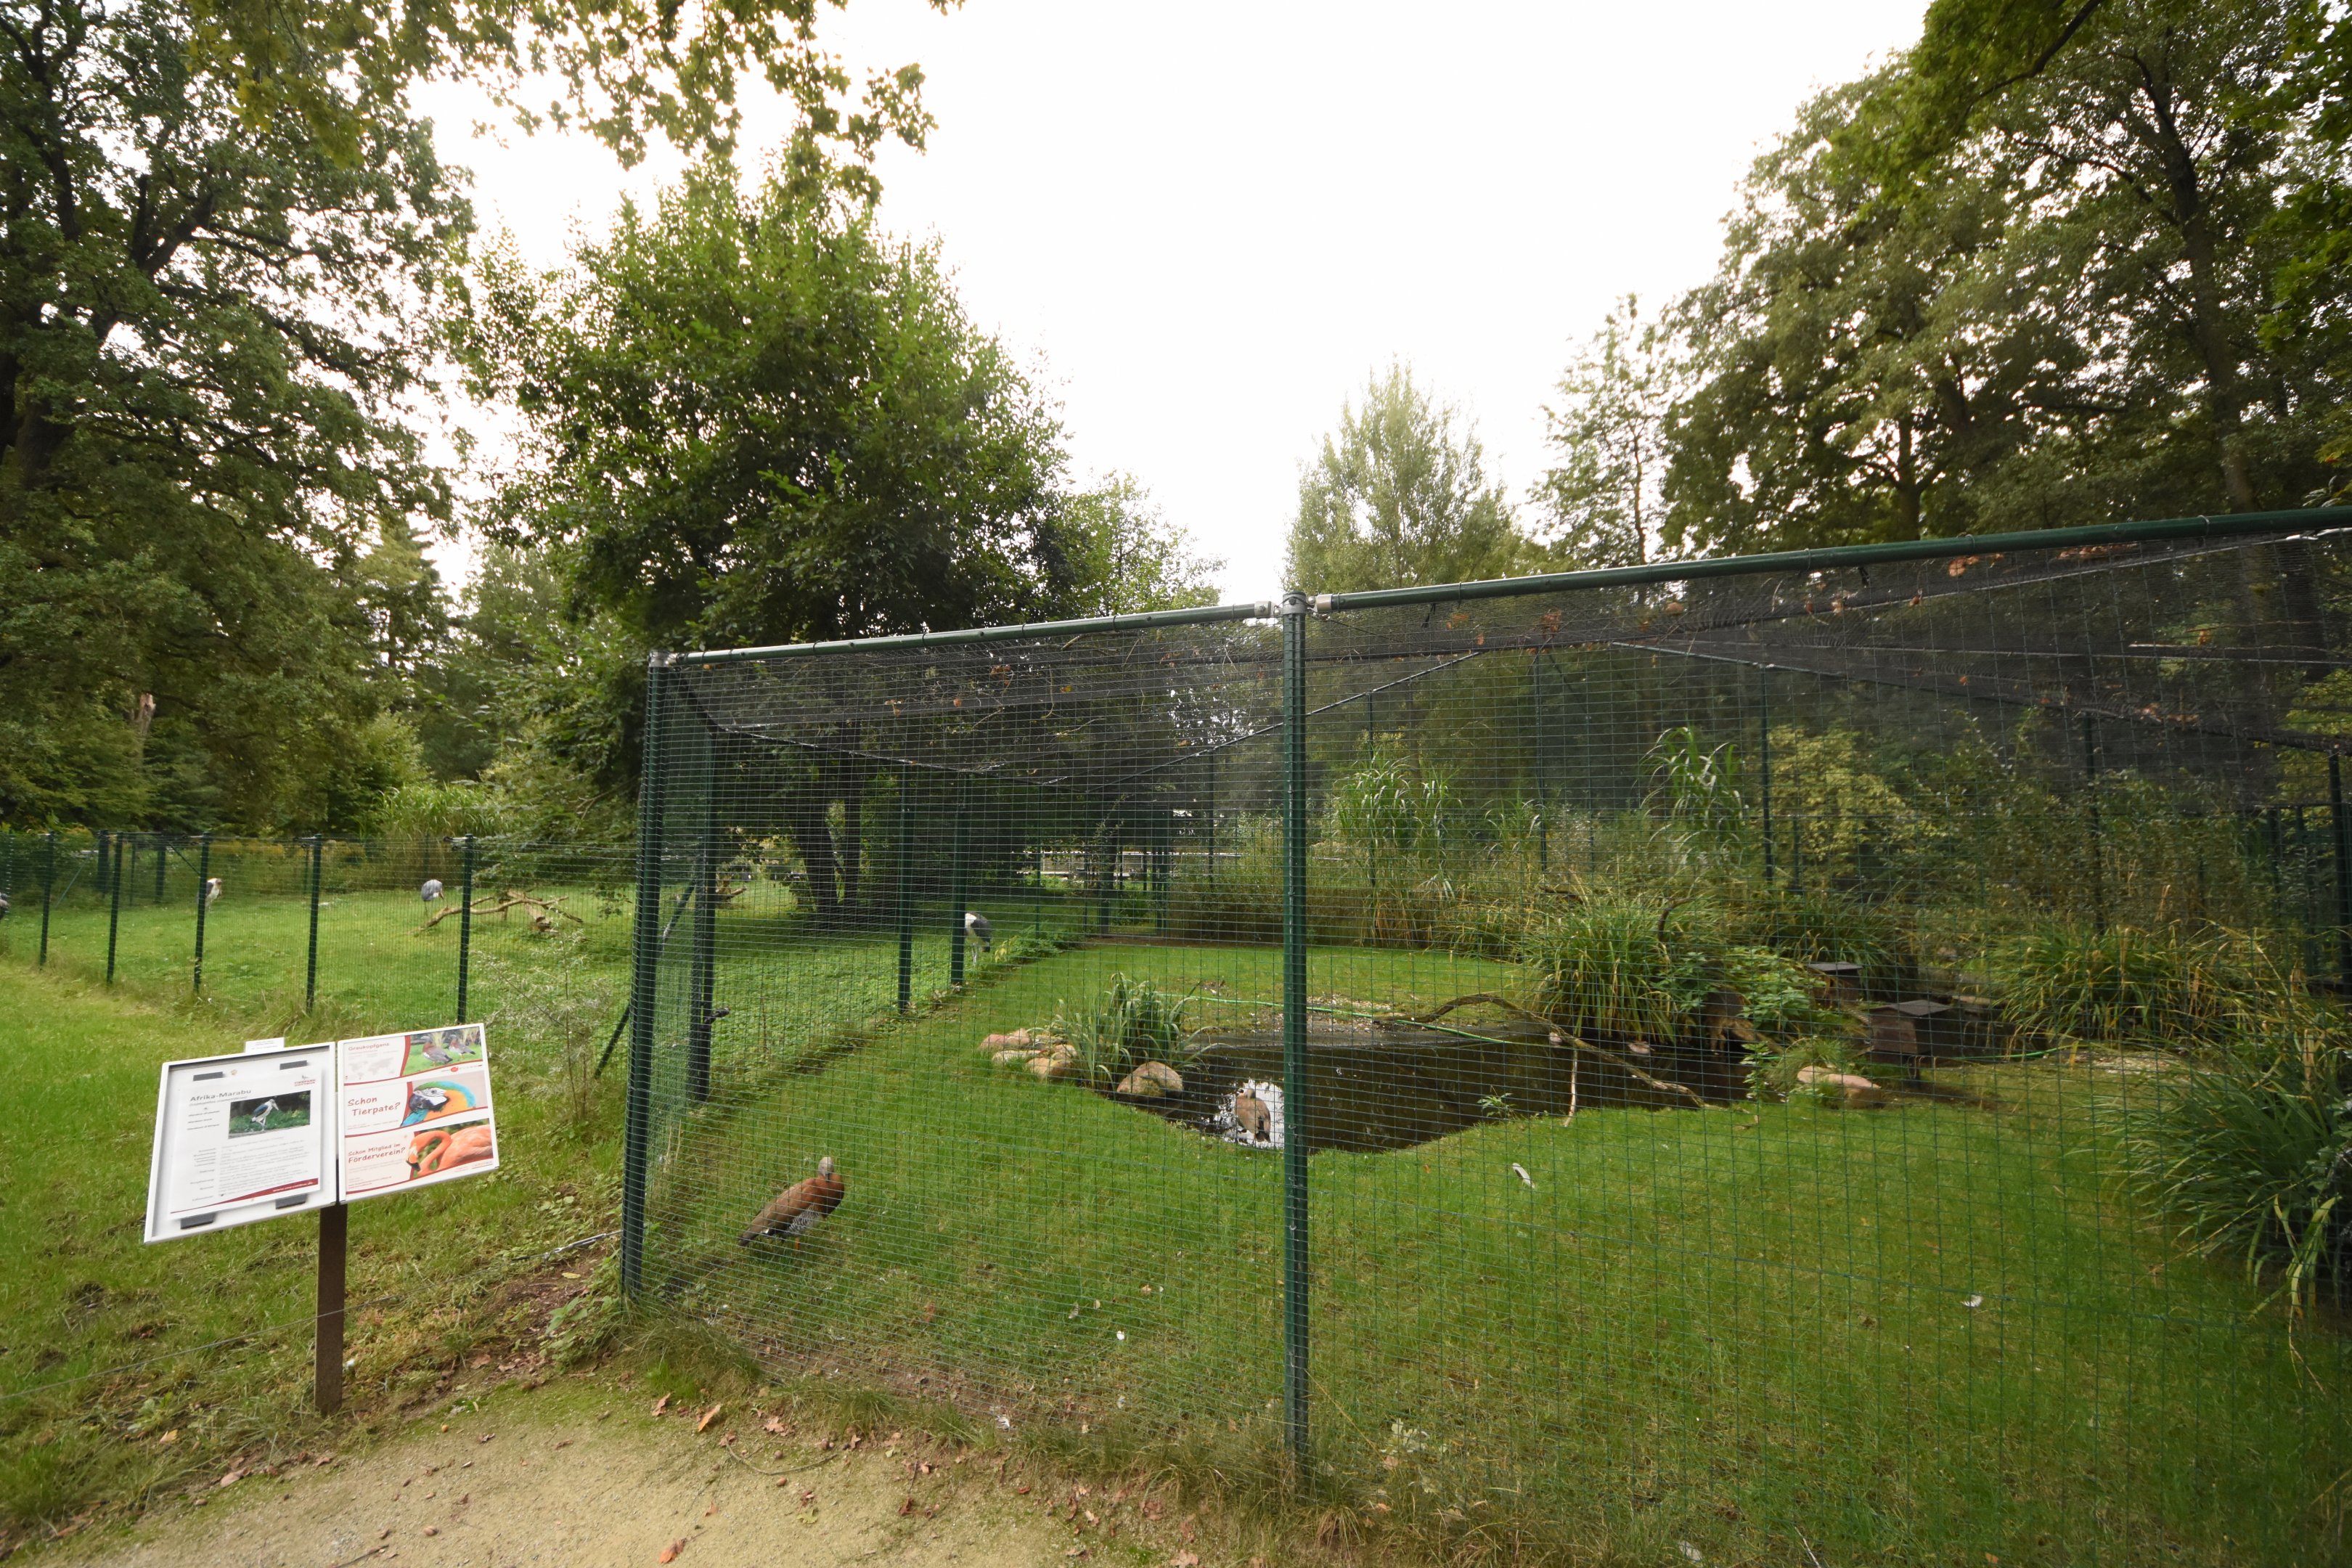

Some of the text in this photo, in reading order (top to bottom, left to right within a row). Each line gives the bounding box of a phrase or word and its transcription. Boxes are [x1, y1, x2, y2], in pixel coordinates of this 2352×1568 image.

[190, 1089, 251, 1102] Afrika-Marabu
[348, 1097, 377, 1106] Schon
[352, 1102, 401, 1116] Tierpate?
[368, 1144, 392, 1153] Mitglied
